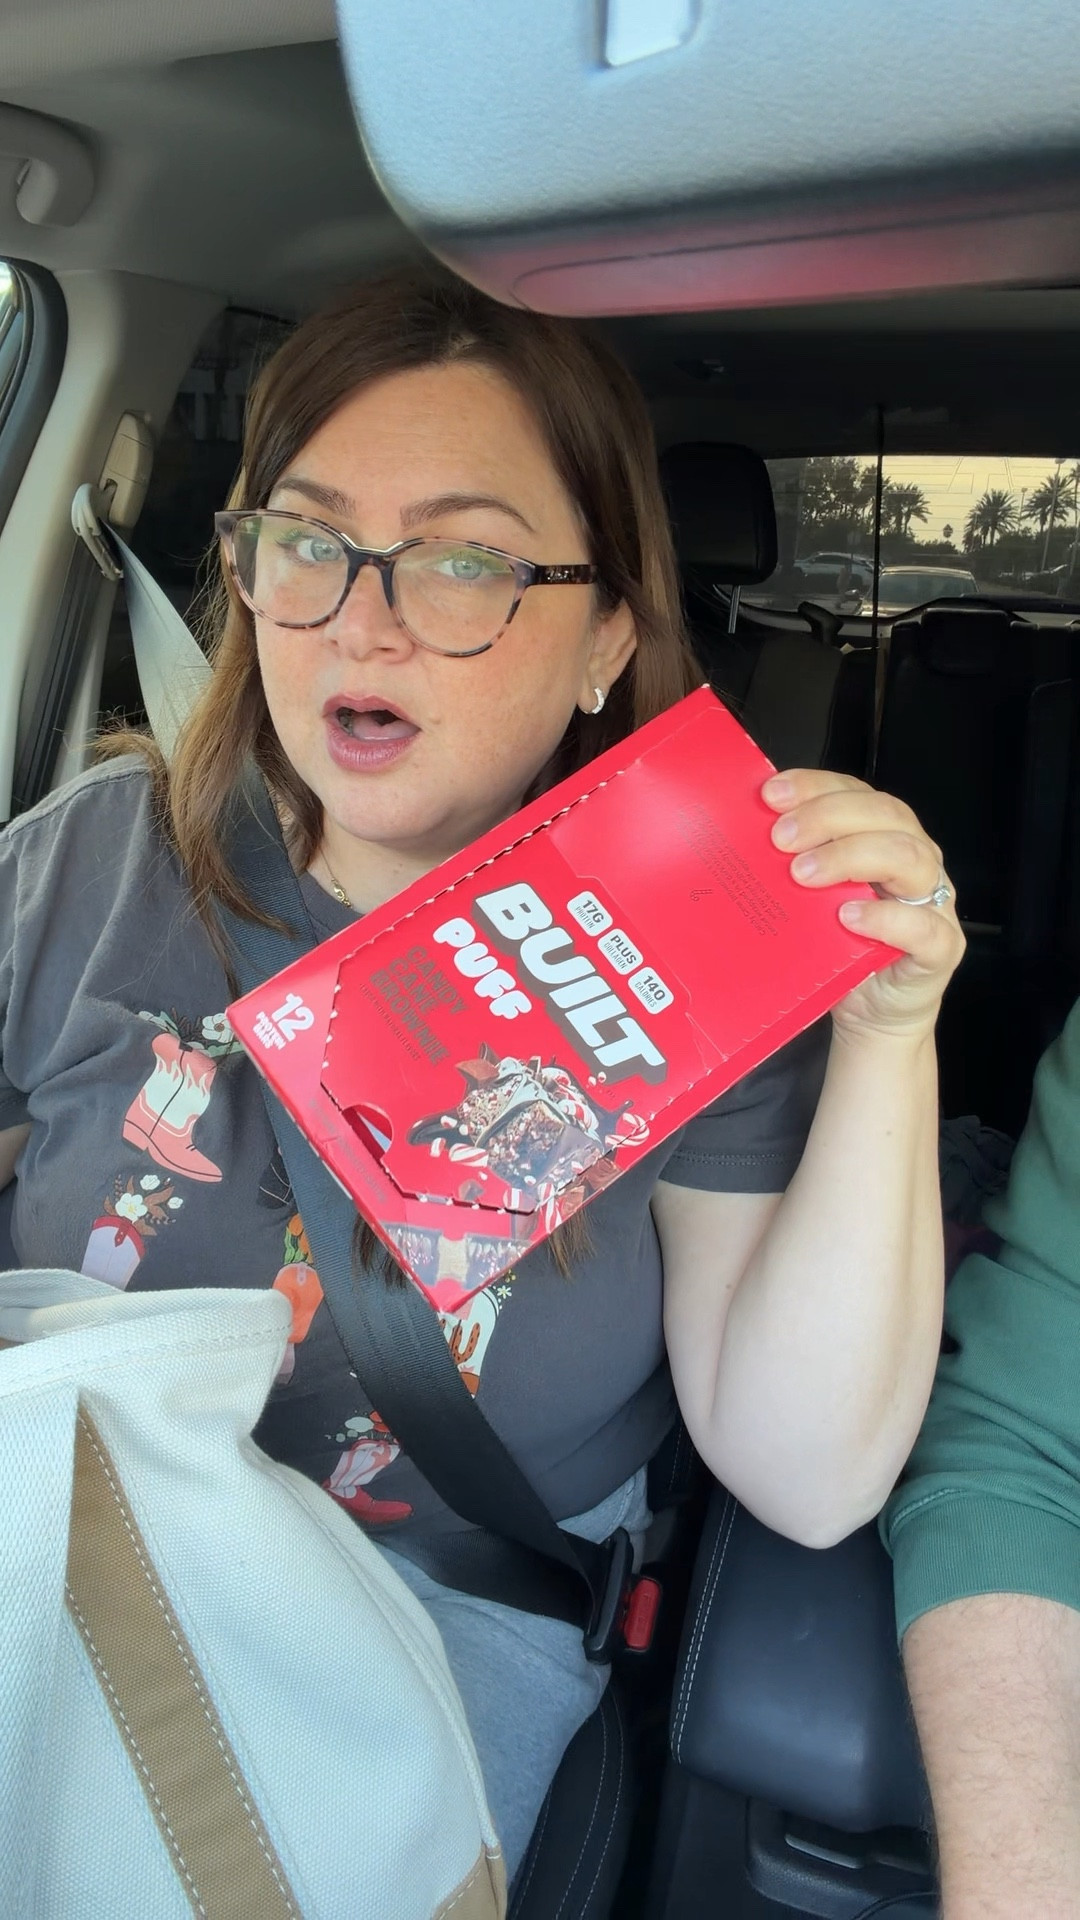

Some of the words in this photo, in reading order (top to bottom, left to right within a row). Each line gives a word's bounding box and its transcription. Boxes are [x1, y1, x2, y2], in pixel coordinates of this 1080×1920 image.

[574, 905, 595, 930] PROTEIN
[580, 898, 605, 925] 17G
[430, 916, 534, 1022] PUFF
[602, 941, 627, 970] COLLAGEN
[609, 933, 637, 965] PLUS
[386, 954, 439, 1015] CANE
[404, 942, 470, 1019] CANDY
[473, 881, 668, 1068] BUILT
[633, 980, 657, 1008] CALORIES
[641, 973, 667, 1002] 140
[272, 992, 315, 1043] 12
[367, 966, 451, 1066] BROWNIE
